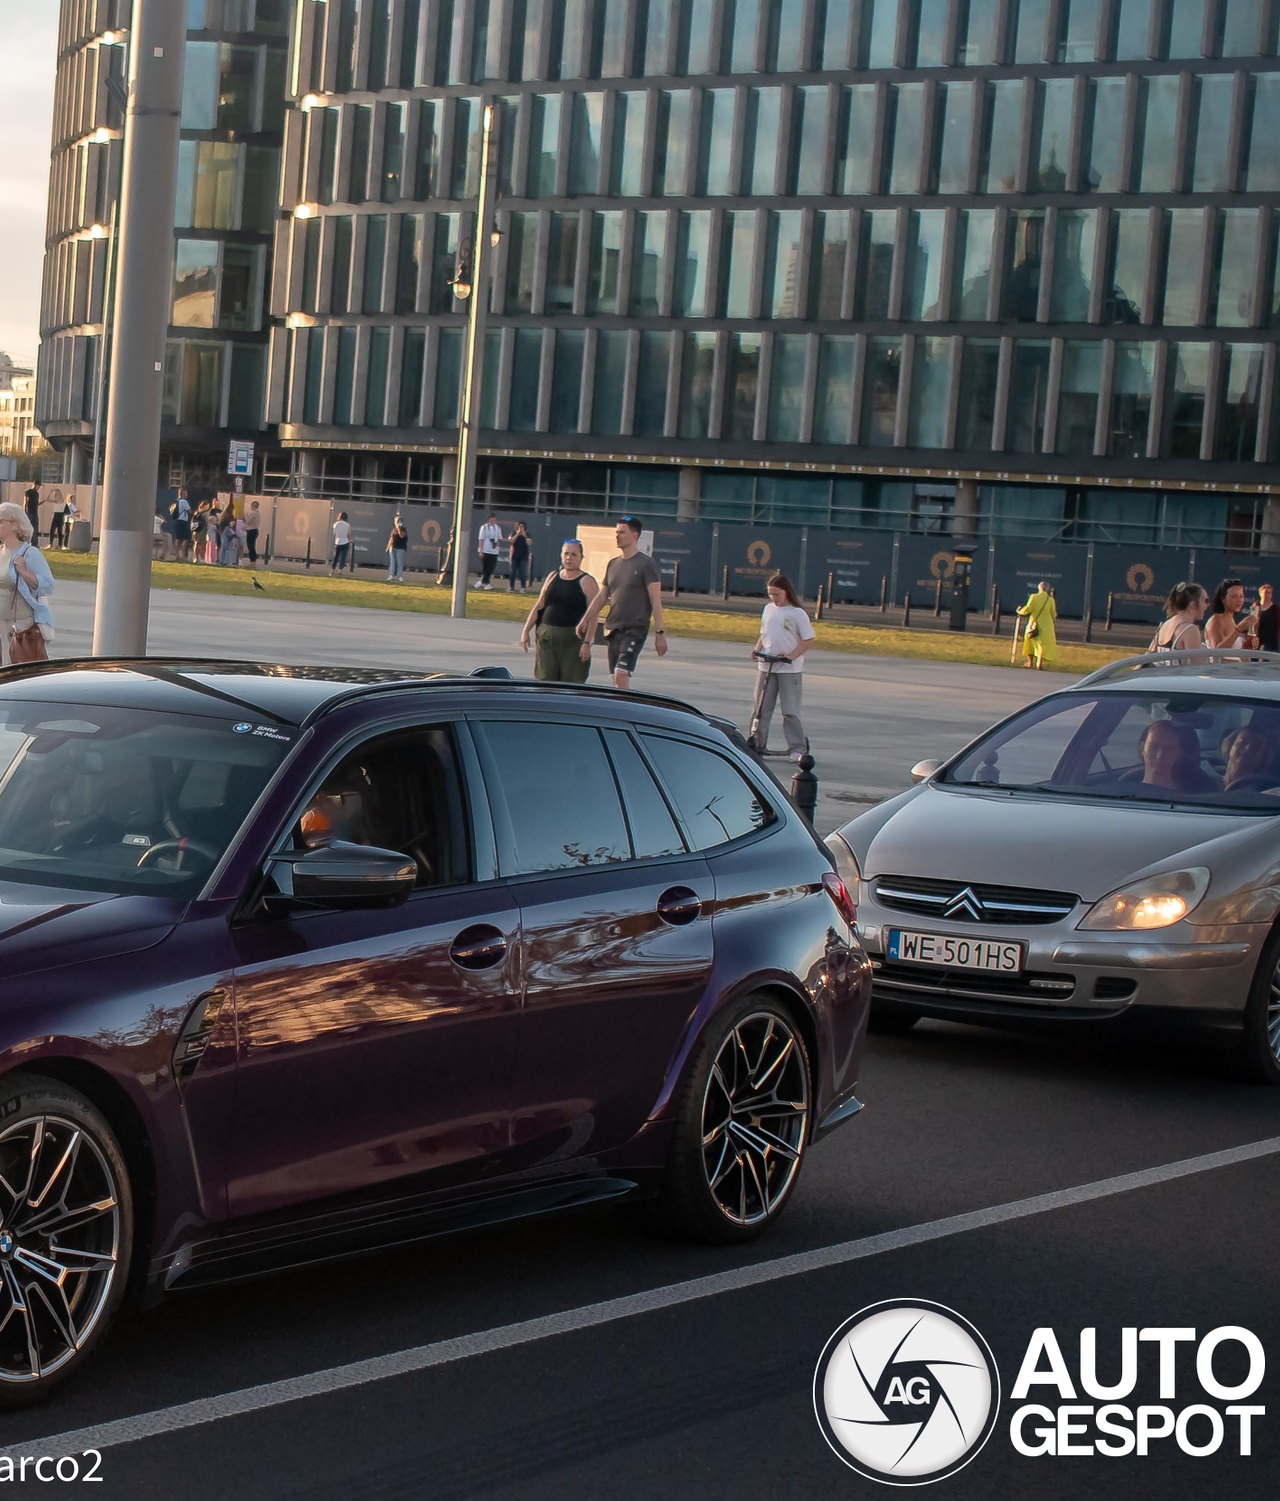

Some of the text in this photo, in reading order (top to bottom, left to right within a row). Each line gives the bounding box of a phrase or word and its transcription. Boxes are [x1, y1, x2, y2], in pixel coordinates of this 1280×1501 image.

[256, 725, 279, 733] BMW
[264, 732, 291, 742] Motors
[890, 934, 1017, 970] PL WE 501HS
